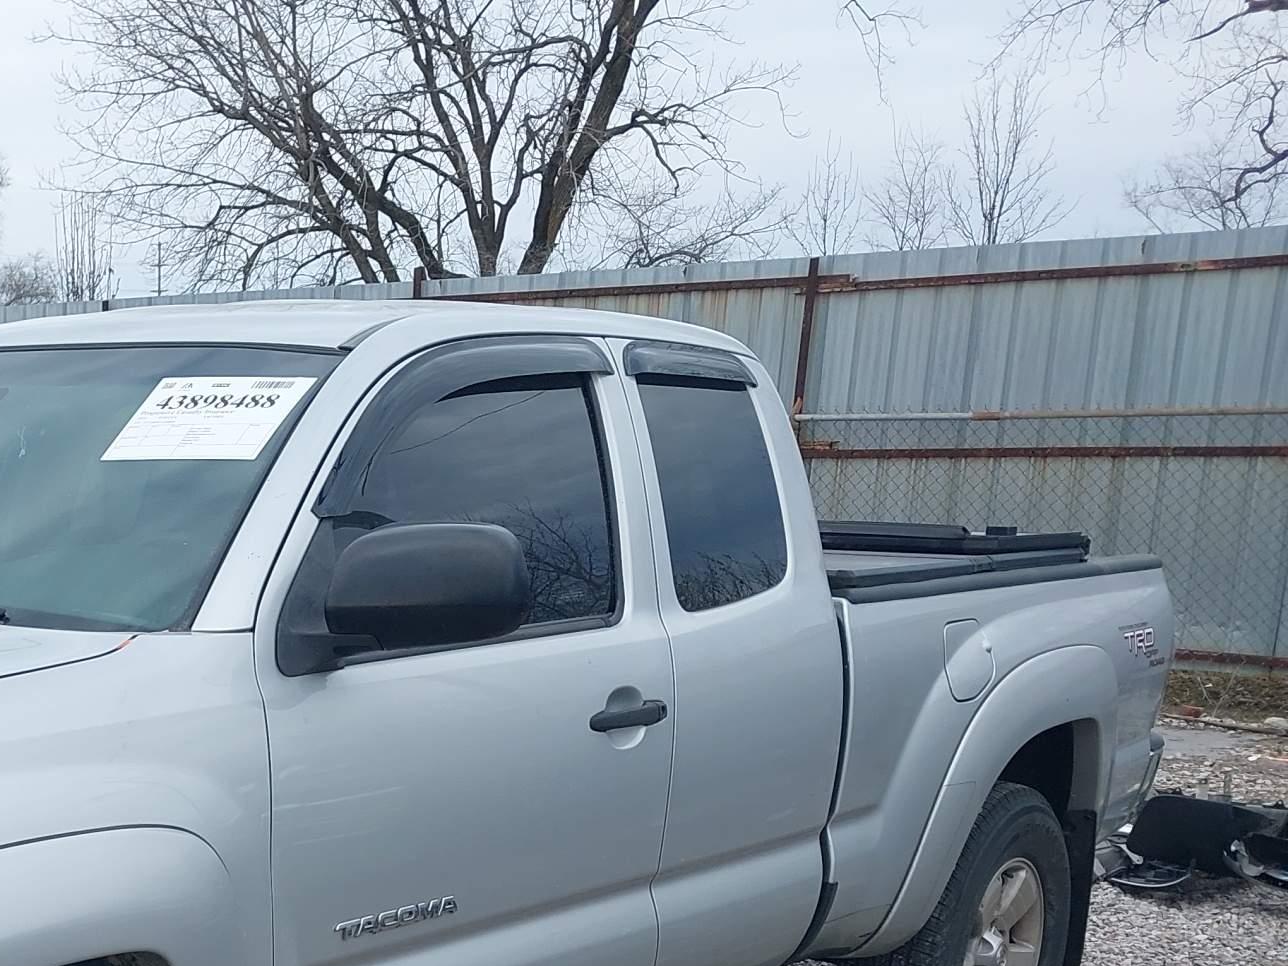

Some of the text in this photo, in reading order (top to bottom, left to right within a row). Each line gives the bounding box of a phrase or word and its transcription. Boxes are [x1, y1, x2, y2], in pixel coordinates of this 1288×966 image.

[156, 394, 280, 410] 43898488
[1123, 627, 1155, 656] TRD
[334, 895, 458, 940] TACOMA
